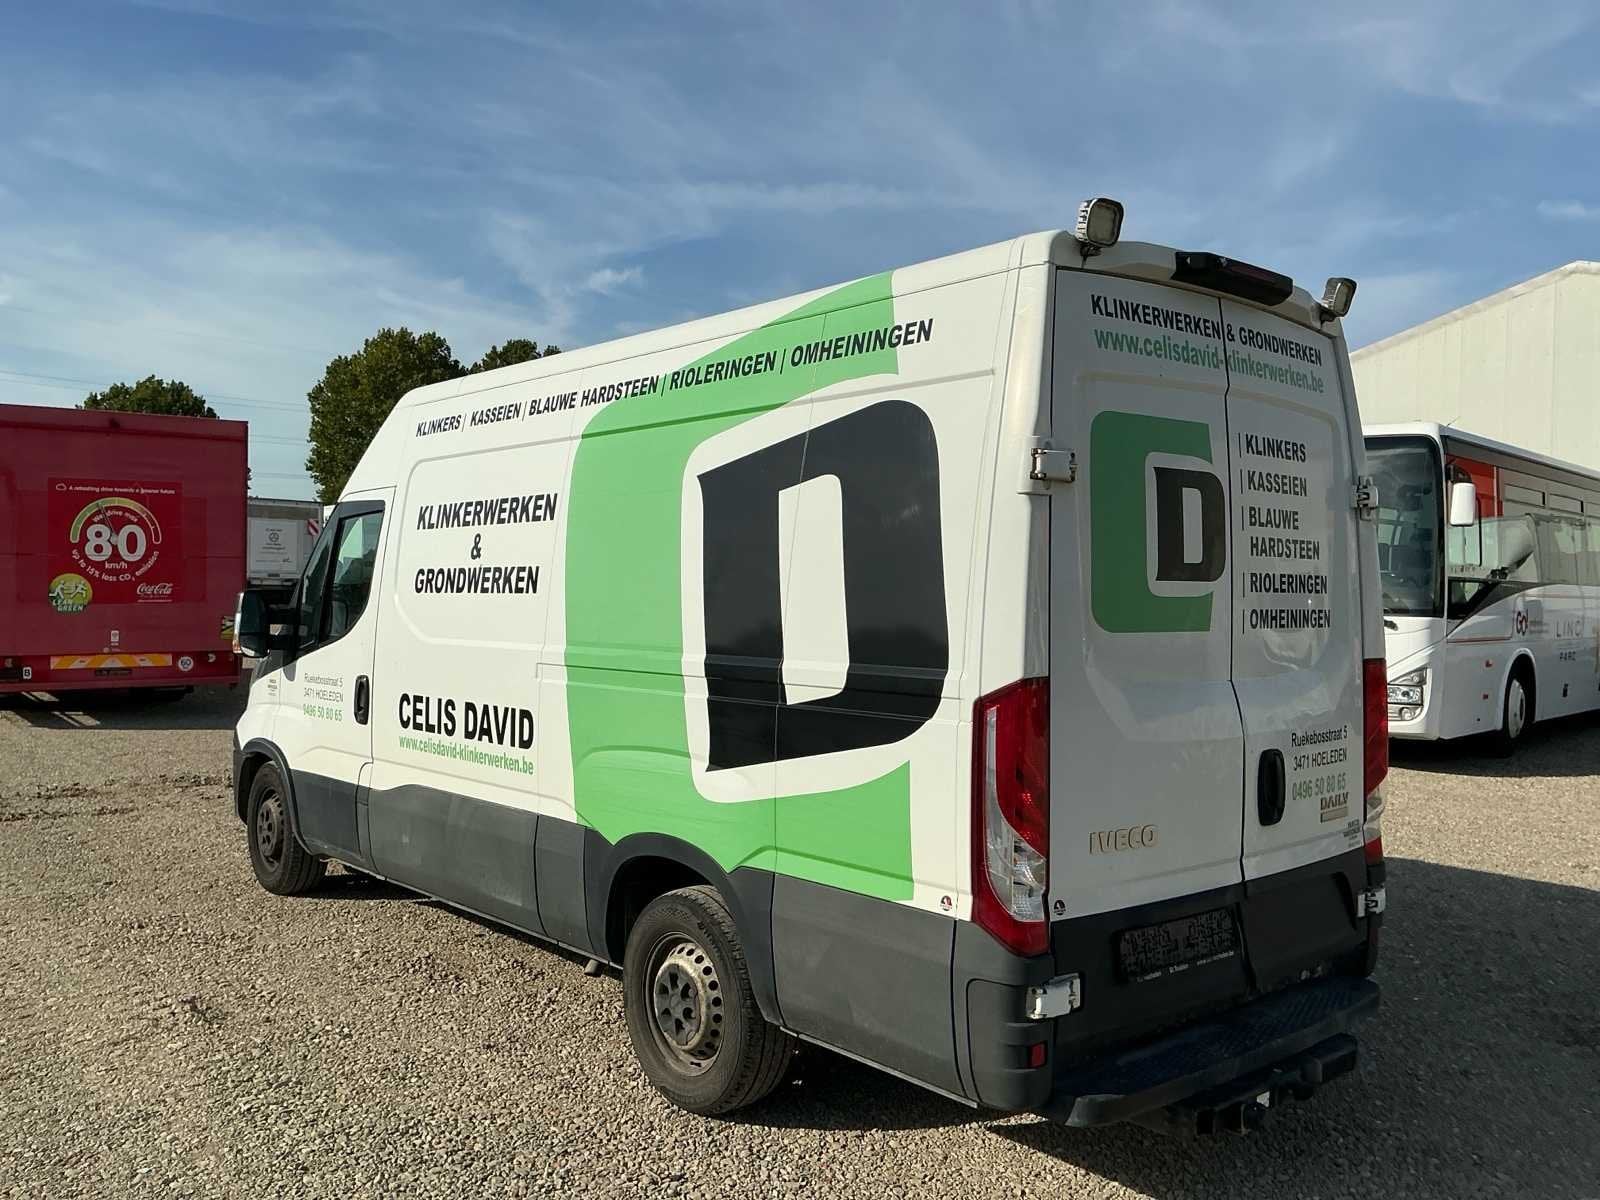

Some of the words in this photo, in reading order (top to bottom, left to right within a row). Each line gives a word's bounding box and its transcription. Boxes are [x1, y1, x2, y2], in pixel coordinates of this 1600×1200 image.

[1091, 294, 1222, 340] KLINKERWERKEN
[1226, 323, 1236, 342] &
[1239, 326, 1322, 367] GRONDWERKEN
[416, 414, 462, 437] KLINKERS
[470, 403, 521, 427] KASSEIEN
[528, 392, 578, 416] BLAUWE
[580, 375, 660, 408] HARDSTEEN
[669, 349, 778, 391] RIOLERINGEN
[790, 318, 934, 367] OMHEININGEN
[1245, 433, 1307, 463] KLINKERS
[1247, 470, 1308, 497] KASSEIEN
[416, 493, 558, 530] KLINKERWERKEN
[1249, 506, 1299, 530] BLAUWE
[84, 524, 147, 562] 80
[470, 533, 482, 560] &
[1250, 536, 1320, 560] HARDSTEEN
[105, 561, 128, 569] km/h
[415, 566, 540, 594] GRONDWERKEN
[1250, 572, 1328, 595] RIOLERINGEN
[1250, 608, 1330, 629] OMHEININGEN
[335, 709, 343, 721] 65
[399, 693, 456, 738] CELIS
[464, 701, 534, 750] DAVID
[1291, 729, 1343, 748] Ruekebosstraat
[1343, 725, 1348, 739] 5
[399, 735, 534, 776] www.celisdavid-klinkerwerken.be
[1293, 754, 1310, 771] 3471
[1311, 747, 1347, 768] HOELEDEN
[1292, 779, 1313, 800] 0496
[1315, 777, 1324, 796] 50
[1326, 774, 1336, 793] 80
[1337, 772, 1346, 790] 65
[1089, 824, 1157, 854] IVECO
